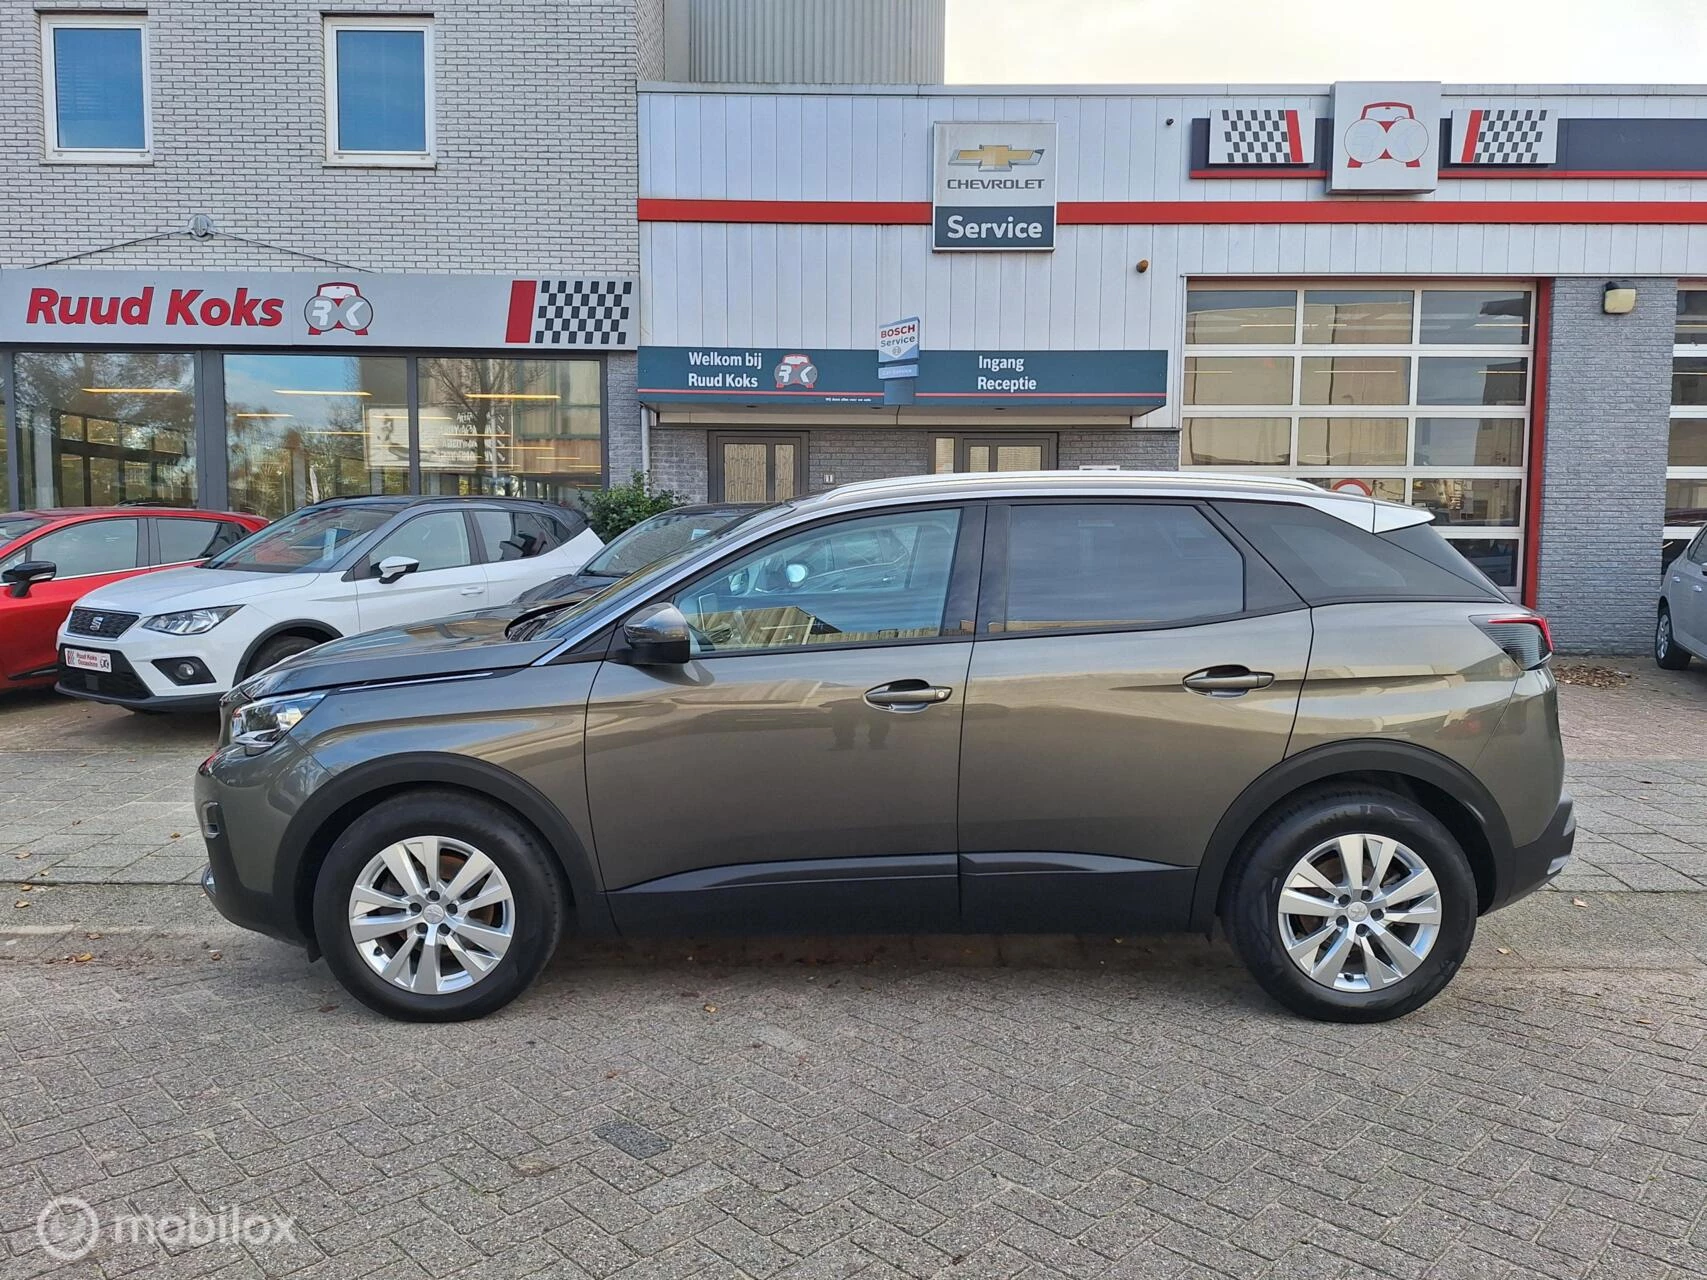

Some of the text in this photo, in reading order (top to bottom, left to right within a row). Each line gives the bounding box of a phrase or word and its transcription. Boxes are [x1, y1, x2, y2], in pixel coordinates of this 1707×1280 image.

[947, 179, 1045, 190] CHEVROLET
[947, 215, 1043, 238] Service
[26, 286, 284, 327] Ruud Koks
[880, 324, 916, 339] BOSCH
[880, 335, 916, 348] Service
[688, 351, 762, 369] Welkom bij
[978, 355, 1025, 372] Ingang
[688, 372, 759, 388] Ruud Koks
[977, 376, 1037, 393] Receptie
